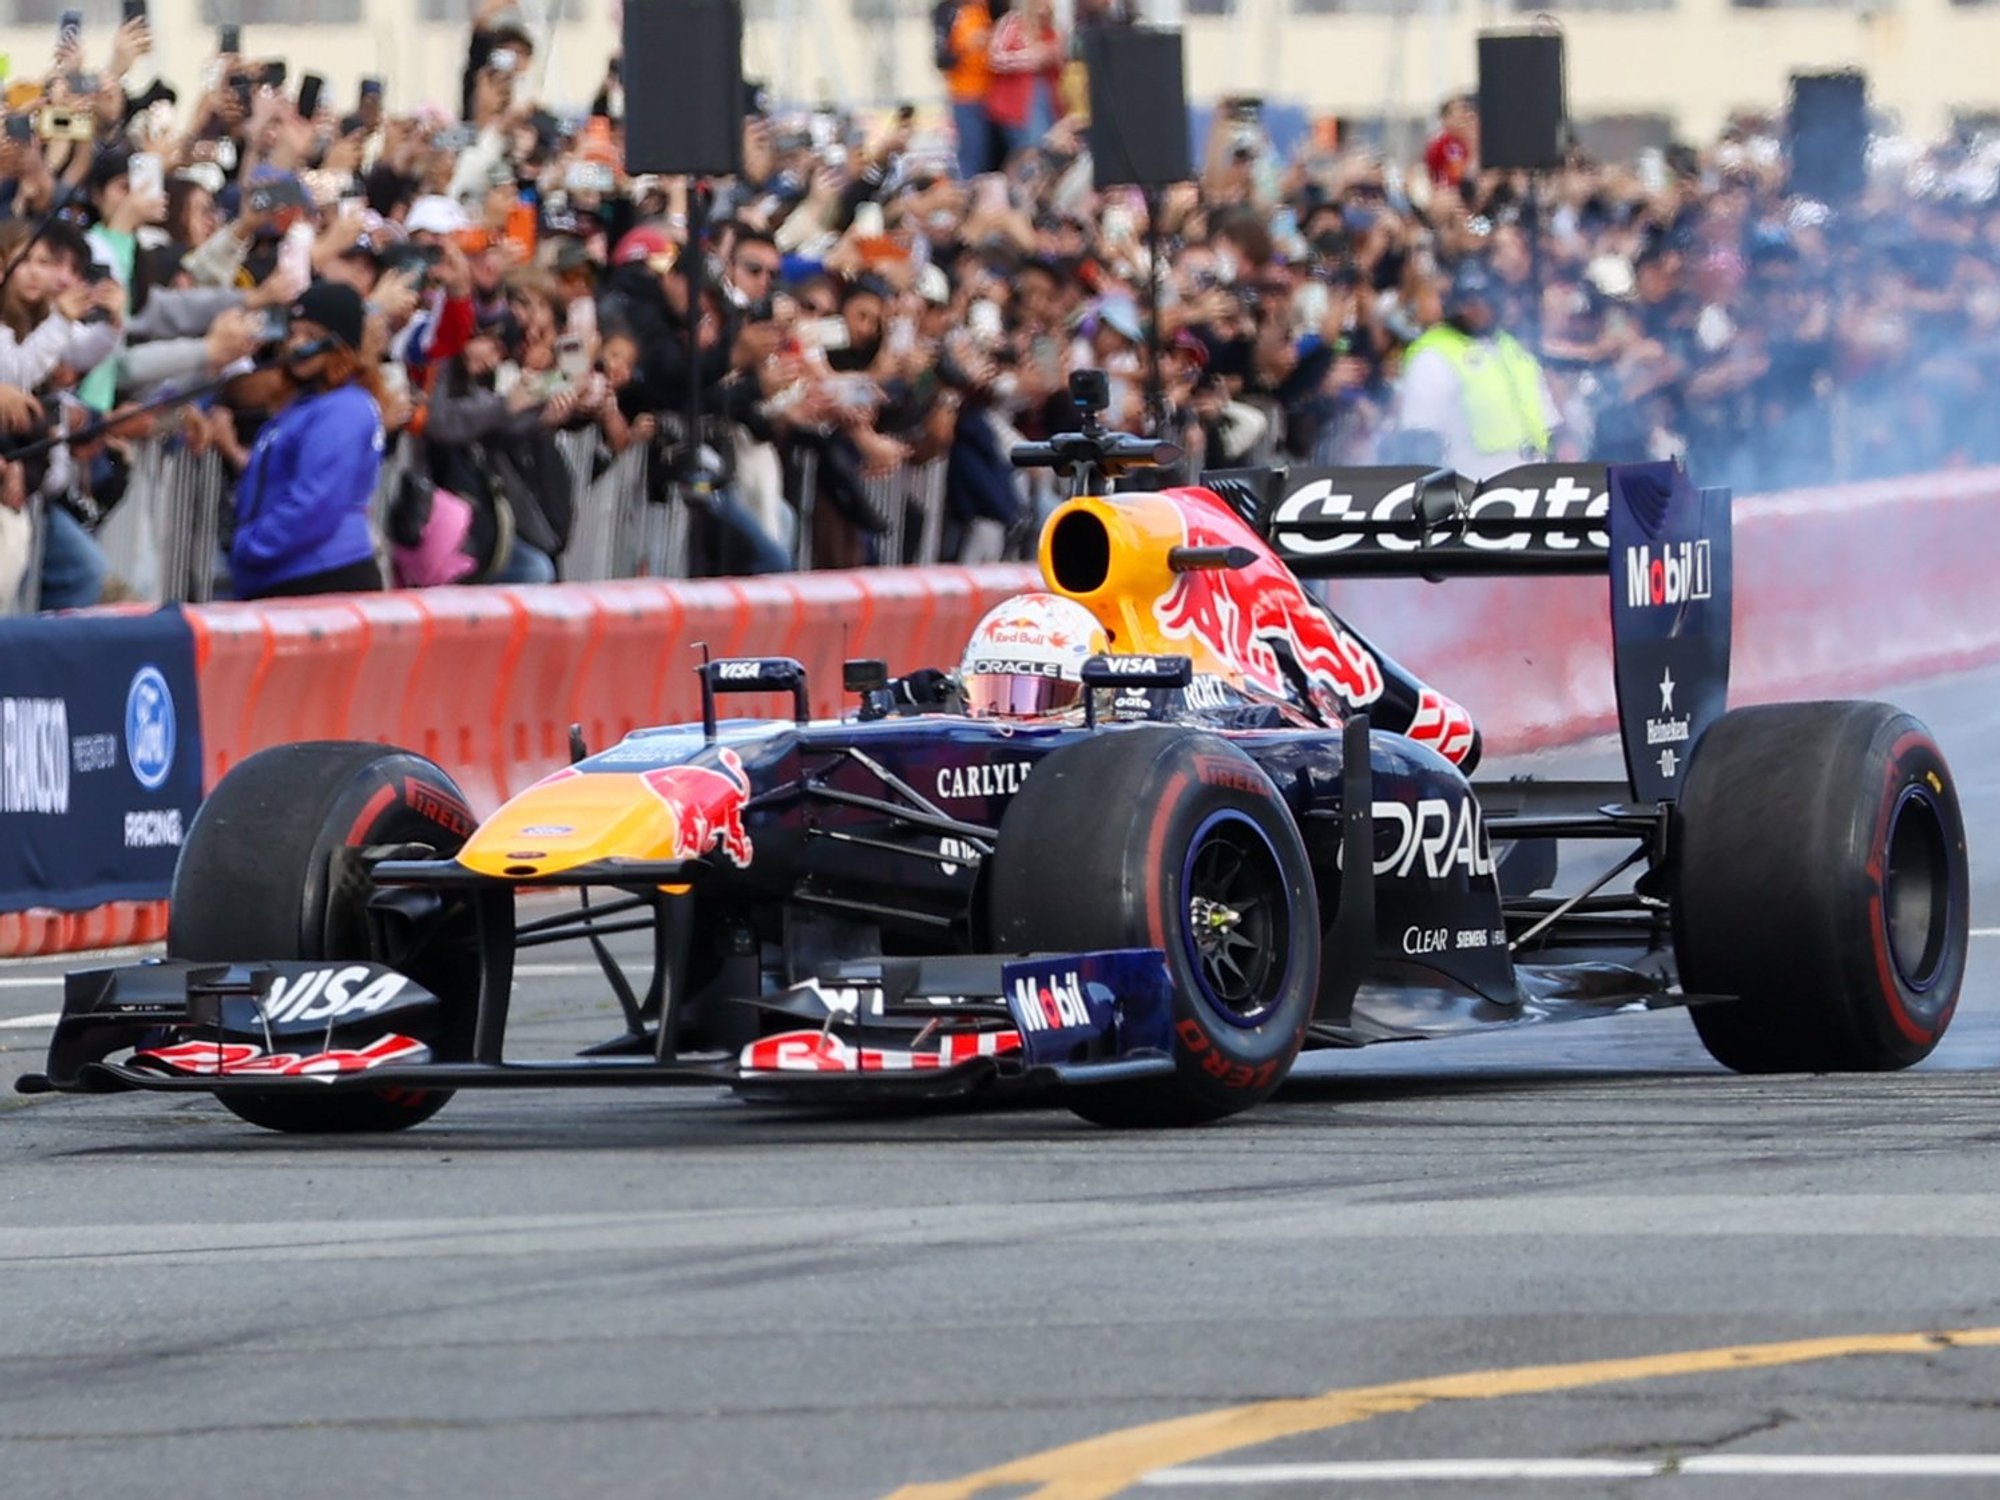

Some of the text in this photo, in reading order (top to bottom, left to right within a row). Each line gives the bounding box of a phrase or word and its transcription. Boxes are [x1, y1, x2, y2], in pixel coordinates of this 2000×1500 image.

[1626, 541, 1693, 608] Mobil
[996, 632, 1044, 645] Red Bull
[719, 662, 760, 679] VISA
[976, 660, 1058, 678] ORACLE
[1104, 657, 1158, 674] VISA
[124, 809, 183, 847] RACING
[251, 966, 410, 1023] VISA
[1015, 971, 1091, 1032] Mobil
